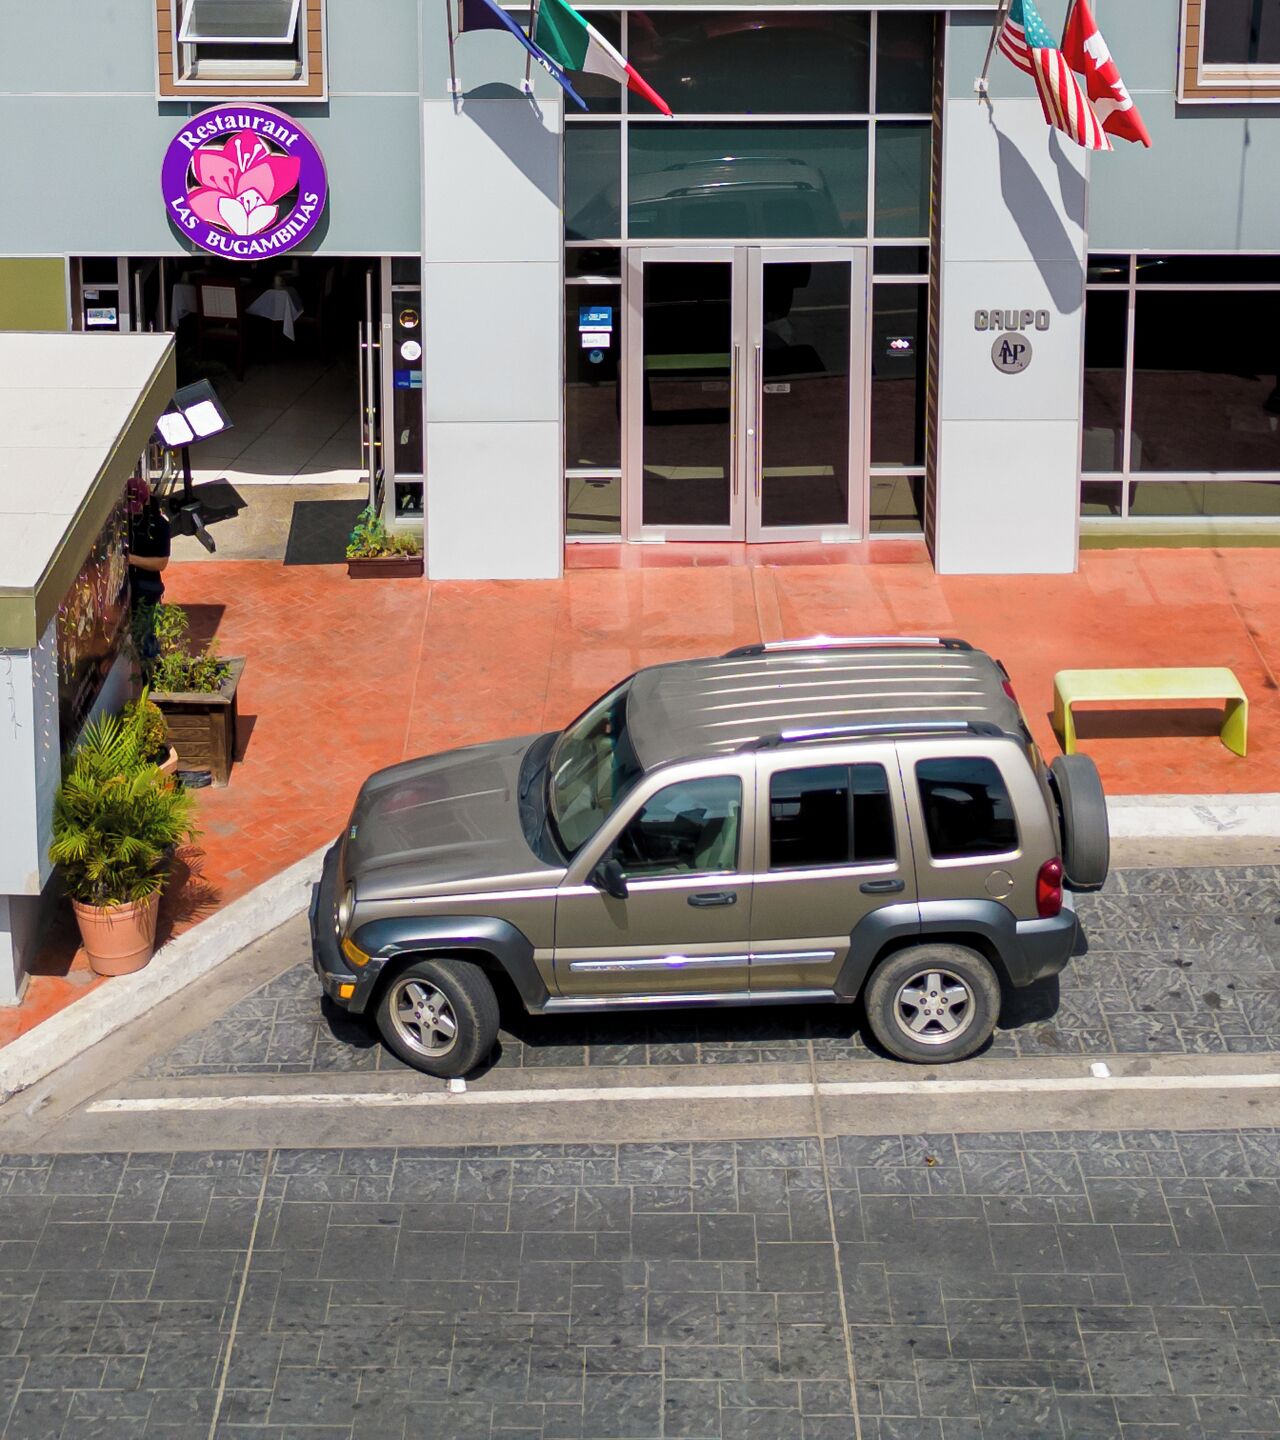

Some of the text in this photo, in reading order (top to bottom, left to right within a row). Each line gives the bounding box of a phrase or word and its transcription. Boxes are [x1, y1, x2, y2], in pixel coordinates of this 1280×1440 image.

[177, 114, 300, 152] Restaurant
[171, 191, 319, 255] LAS BUGAMBILIAS
[974, 309, 1050, 331] GRUPO
